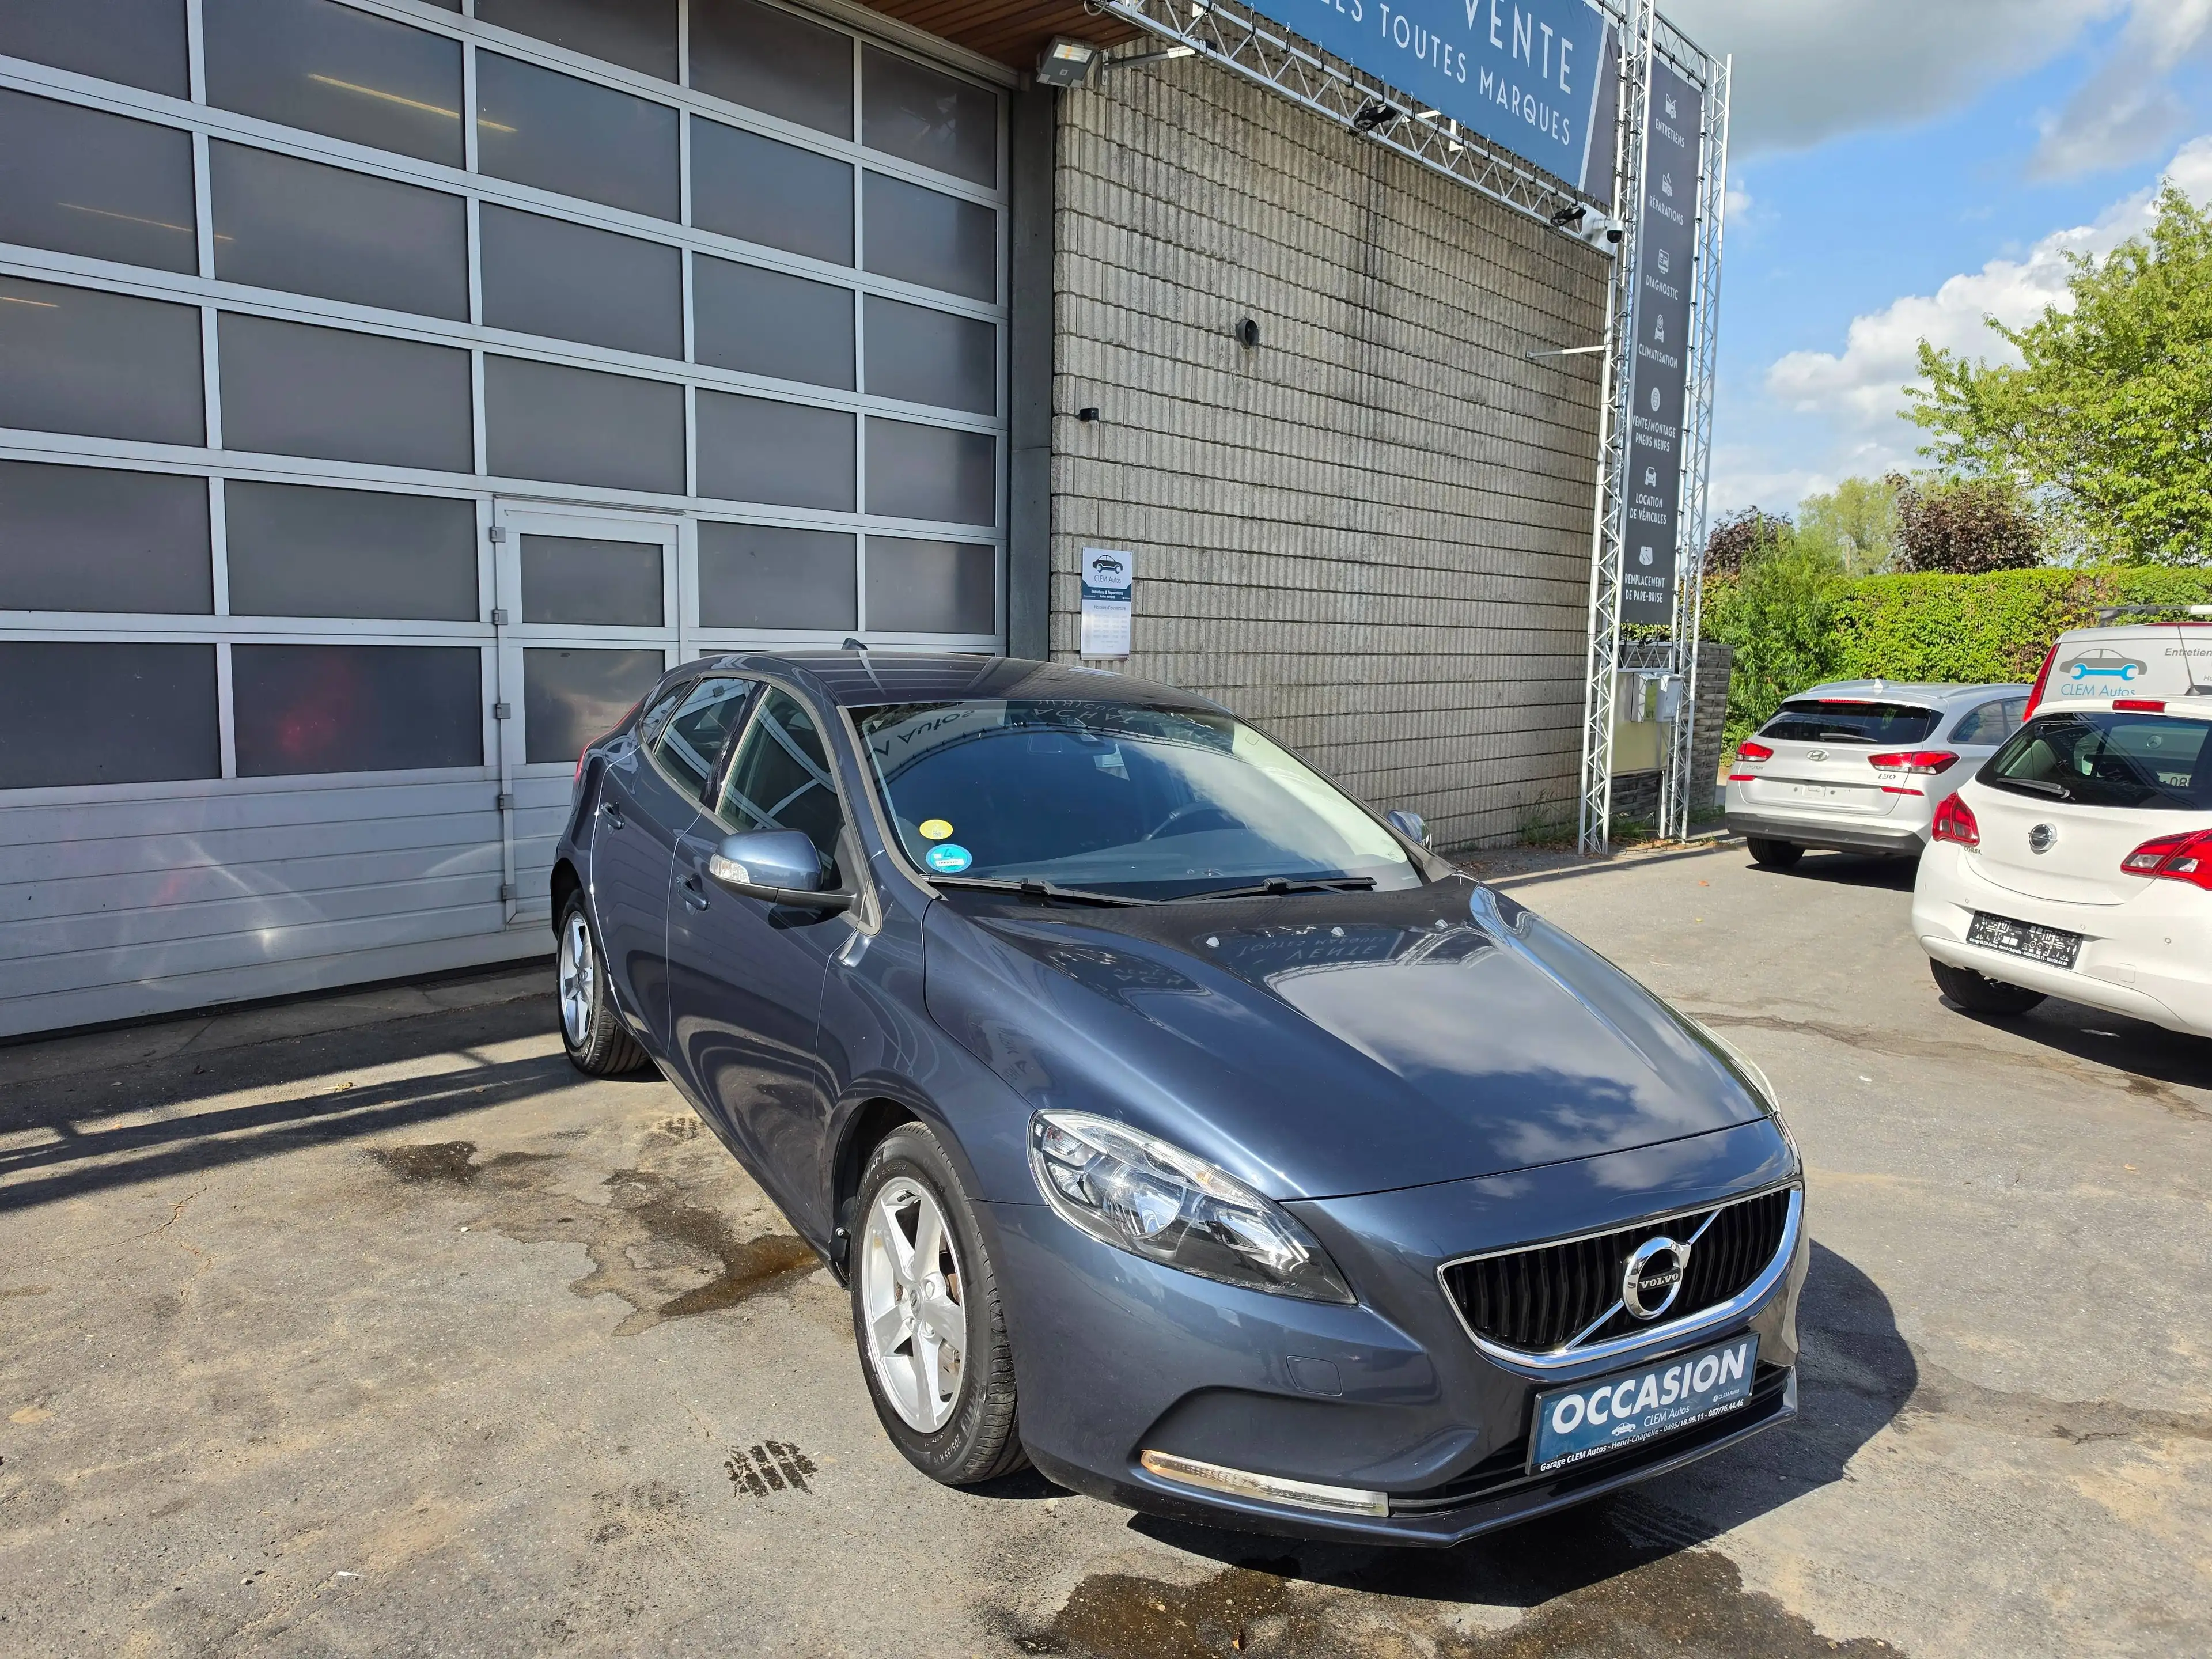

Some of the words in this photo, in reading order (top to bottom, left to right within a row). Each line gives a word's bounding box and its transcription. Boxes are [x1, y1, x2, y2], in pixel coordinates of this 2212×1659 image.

[1380, 3, 1466, 84] TOUTES
[1480, 65, 1570, 145] MARQUES
[1655, 118, 1685, 148] ENTRETIENS
[1649, 194, 1684, 226] RÉPARATIONS
[1646, 274, 1678, 300] DIAGNOSTIC
[1638, 343, 1677, 369] CLIMATISATION
[1632, 414, 1676, 438] VENTE/MONTAGE
[1635, 433, 1652, 448] PNEUS
[1653, 438, 1670, 452] NEUFS
[1635, 493, 1663, 508] LOCATION
[1630, 508, 1637, 519] DE
[1638, 507, 1666, 525] VÉHICULES
[1094, 574, 1108, 583] CLEM
[1624, 573, 1665, 588] REMPLACEMENT
[1625, 589, 1633, 600] DE
[1634, 590, 1663, 603] PARE-BRISE
[2061, 684, 2095, 696] CLEM
[2099, 687, 2135, 697] Autos
[1639, 1273, 1679, 1289] VOLVO
[1552, 1344, 1747, 1434] OCCASION
[1718, 1392, 1729, 1400] CLEM
[1644, 1412, 1666, 1427] CLEM
[1668, 1406, 1690, 1419] Autos
[1540, 1458, 1565, 1471] Garage
[1567, 1450, 1586, 1463] CLEM
[1586, 1445, 1607, 1457] Autos
[1611, 1429, 1658, 1449] Henri-Chapelle
[1663, 1412, 1704, 1433] 0495/18.99.11
[1708, 1399, 1744, 1418] 087/76.44.46
[944, 1433, 961, 1460] 205/55
[940, 1454, 945, 1463] R
